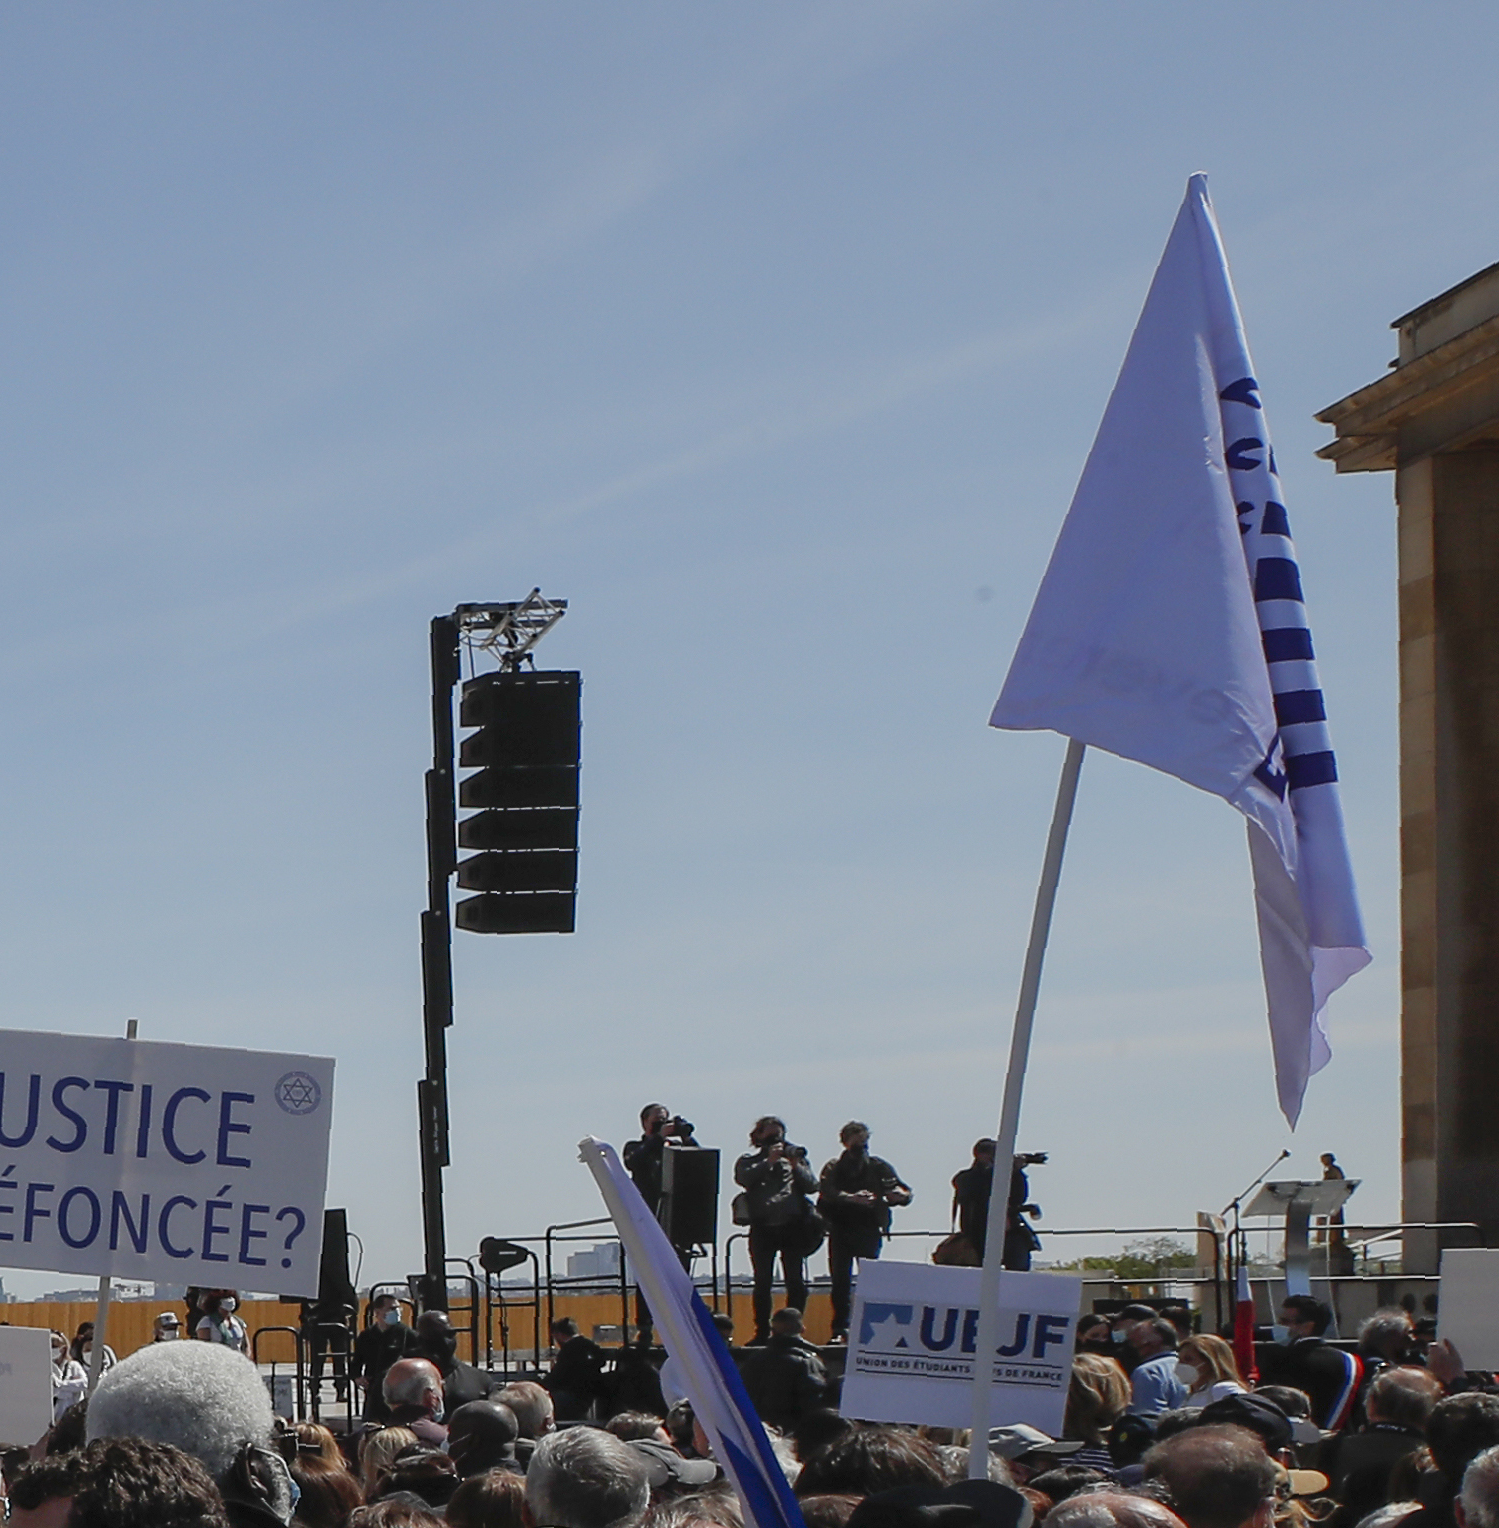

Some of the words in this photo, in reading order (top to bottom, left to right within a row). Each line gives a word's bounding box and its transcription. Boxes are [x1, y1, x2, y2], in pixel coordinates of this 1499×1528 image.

[856, 1357, 889, 1368] UNION
[891, 1358, 910, 1369] DES
[913, 1359, 971, 1374] ÉTUDIANTS
[1005, 1368, 1019, 1378] DE
[1022, 1369, 1063, 1381] FRANCE
